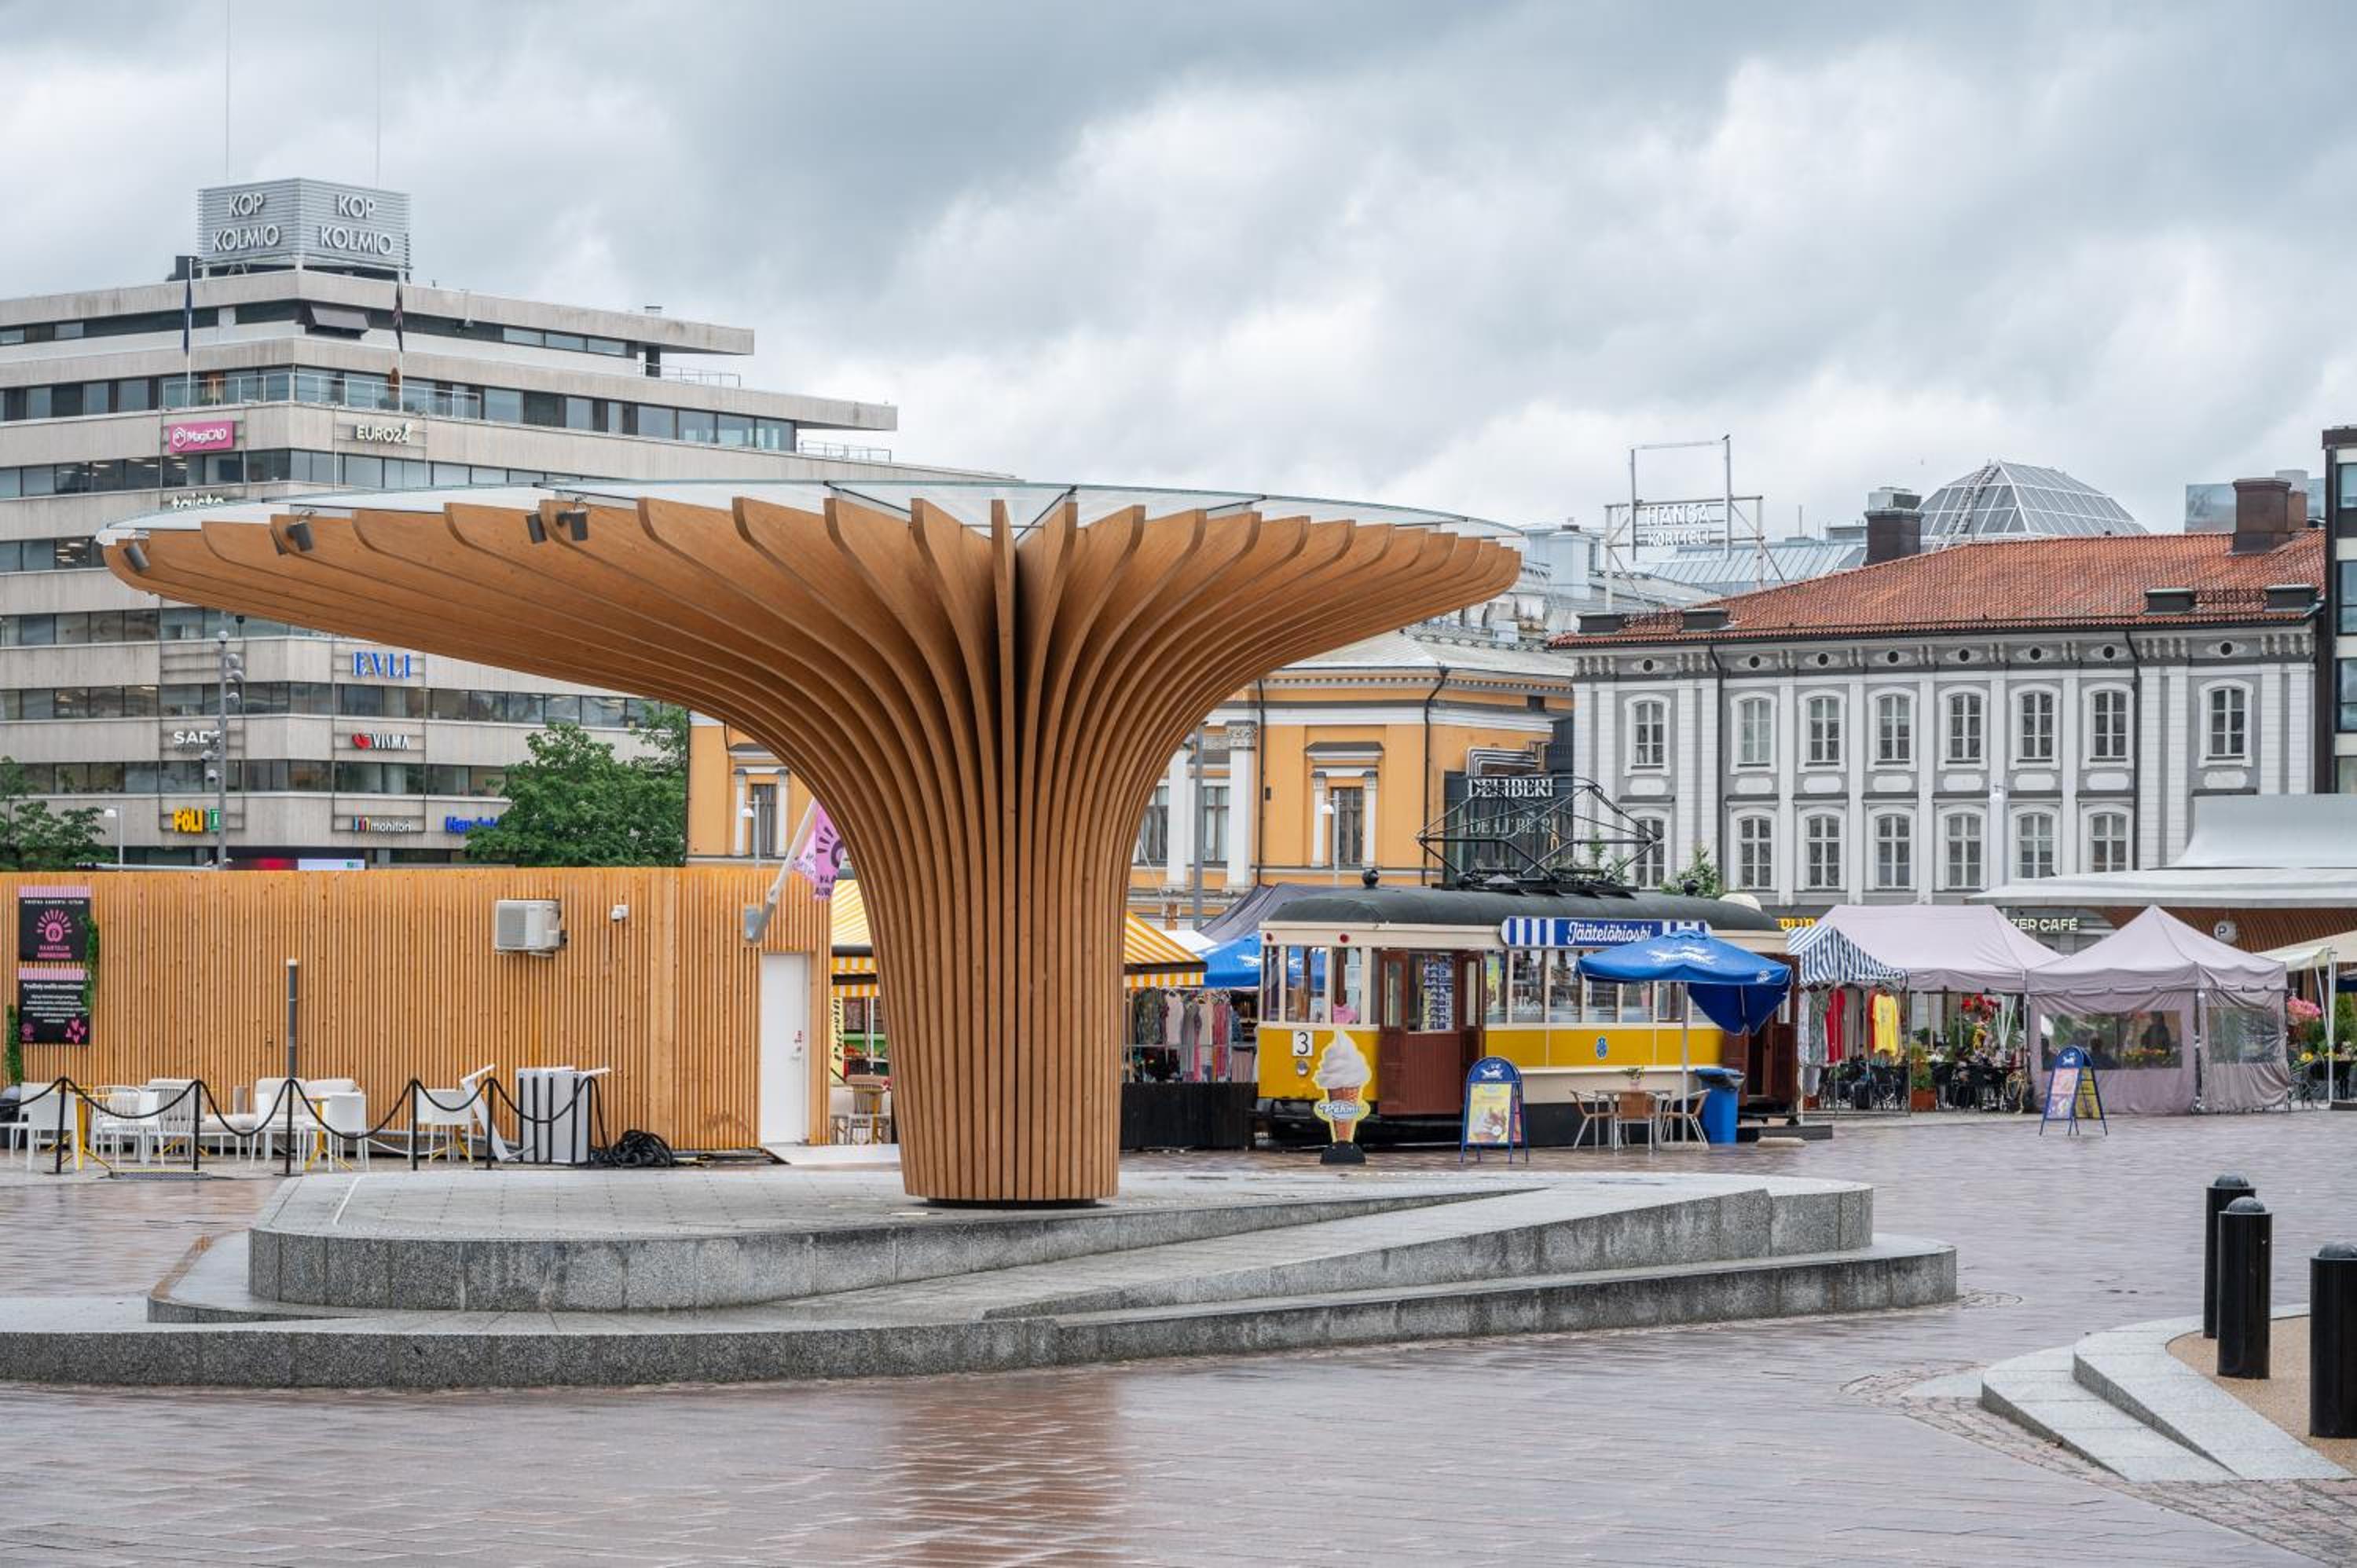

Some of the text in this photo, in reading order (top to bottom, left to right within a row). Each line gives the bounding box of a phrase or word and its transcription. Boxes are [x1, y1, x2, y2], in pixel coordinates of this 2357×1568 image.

[228, 193, 264, 217] KOP
[338, 195, 376, 218] KOP
[213, 225, 280, 251] KOLMIO
[320, 226, 394, 255] KOLMIO
[1648, 504, 1710, 525] HANSA
[353, 652, 411, 679] EVLI
[372, 733, 409, 750] VISMA
[1468, 778, 1553, 797] DELIBERI
[1567, 921, 1652, 945] Jäätelökioski
[2039, 918, 2078, 931] CAFÉ
[2218, 925, 2227, 937] P
[1296, 1031, 1309, 1055] 3
